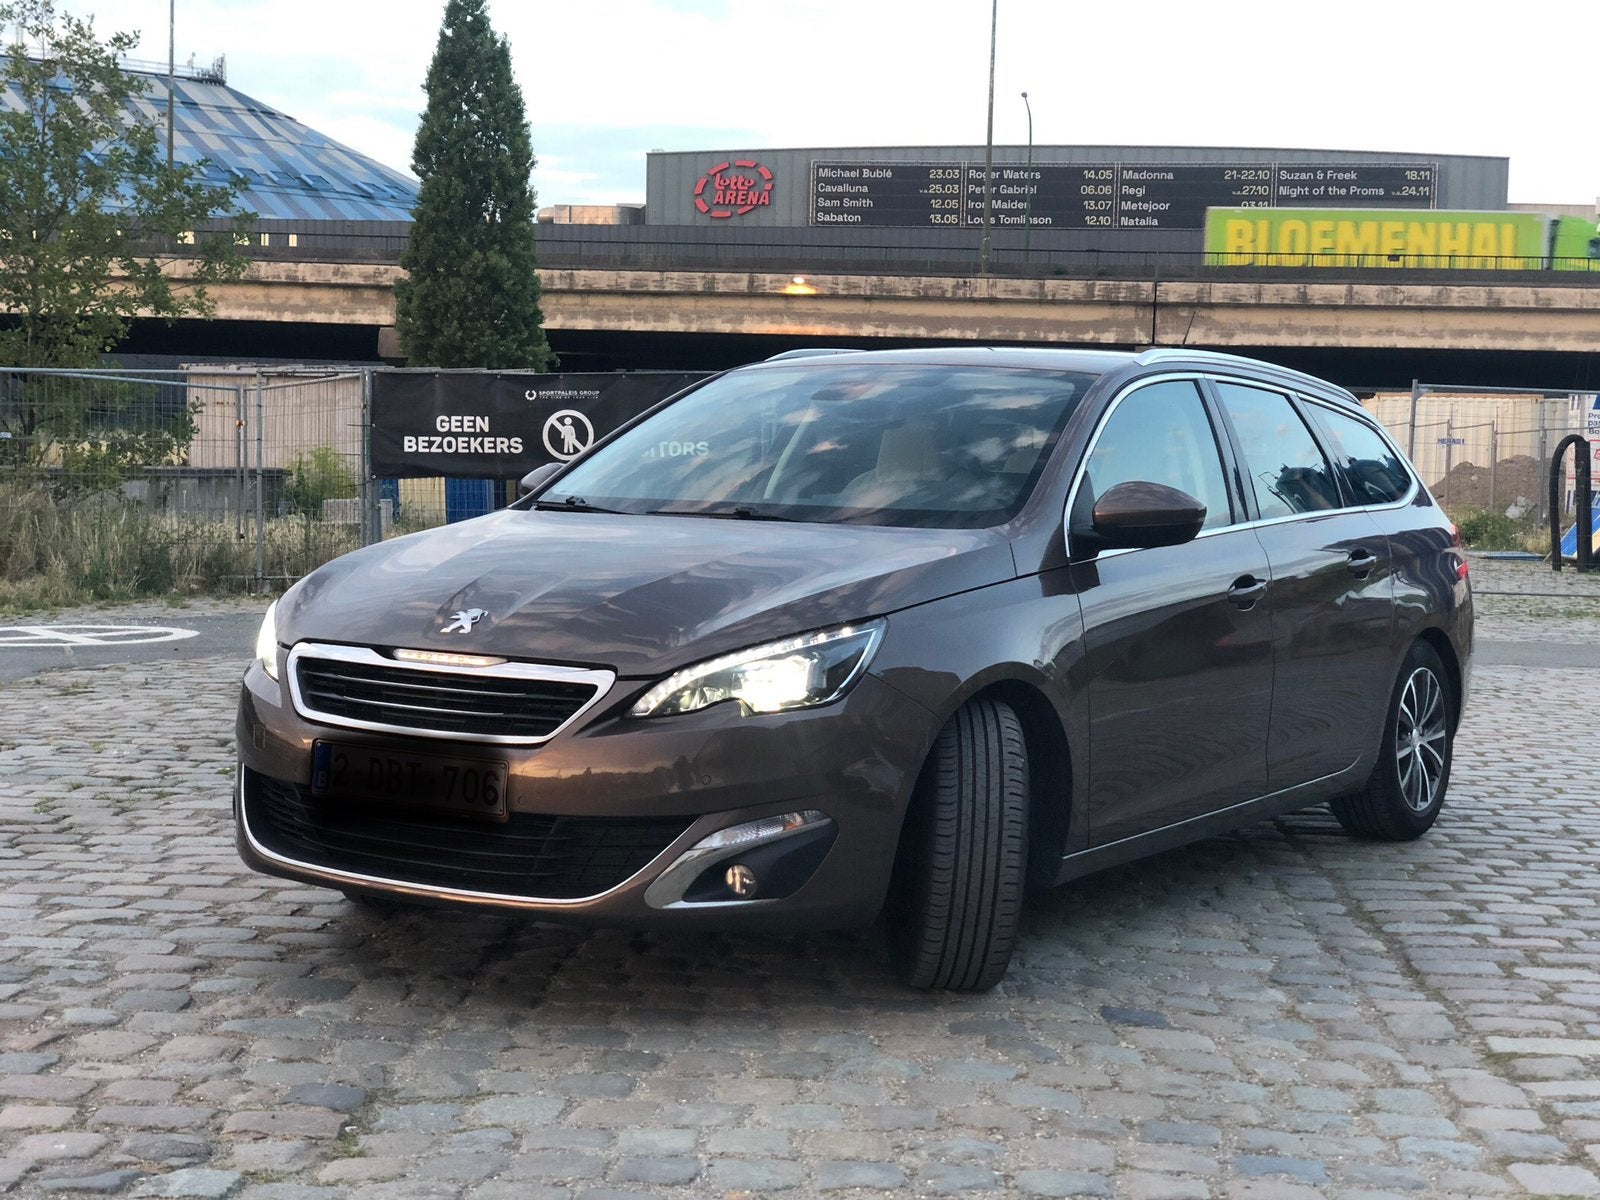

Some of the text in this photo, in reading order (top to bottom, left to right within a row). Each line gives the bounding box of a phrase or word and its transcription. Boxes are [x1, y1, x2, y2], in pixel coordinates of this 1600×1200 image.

[817, 168, 893, 179] Michael Bublé
[929, 169, 960, 180] 23.03
[1003, 169, 1041, 179] Waters
[1082, 169, 1113, 180] 14.05
[1122, 170, 1174, 180] Madonna
[1223, 169, 1270, 181] 21-22.10
[1279, 170, 1358, 181] Suzan & Freek
[1404, 170, 1430, 181] 18.11
[817, 182, 869, 194] Cavalluna
[968, 184, 998, 194] Petr
[1080, 185, 1112, 196] 06.06
[1121, 185, 1146, 197] Regi
[1278, 185, 1385, 198] Night of the Proms
[713, 190, 771, 206] ARENA
[816, 198, 874, 209] Sam Smith
[929, 199, 960, 210] 12.05
[1082, 200, 1112, 211] 13.07
[1120, 201, 1171, 213] Metejoor
[816, 213, 862, 224] Sabaton
[929, 214, 959, 225] 13.05
[967, 214, 996, 225] Lous
[1083, 215, 1111, 226] 12.10
[1119, 216, 1159, 227] Natalia
[436, 415, 490, 433] GEEN
[403, 436, 524, 454] BEZOEKERS
[319, 774, 328, 789] B
